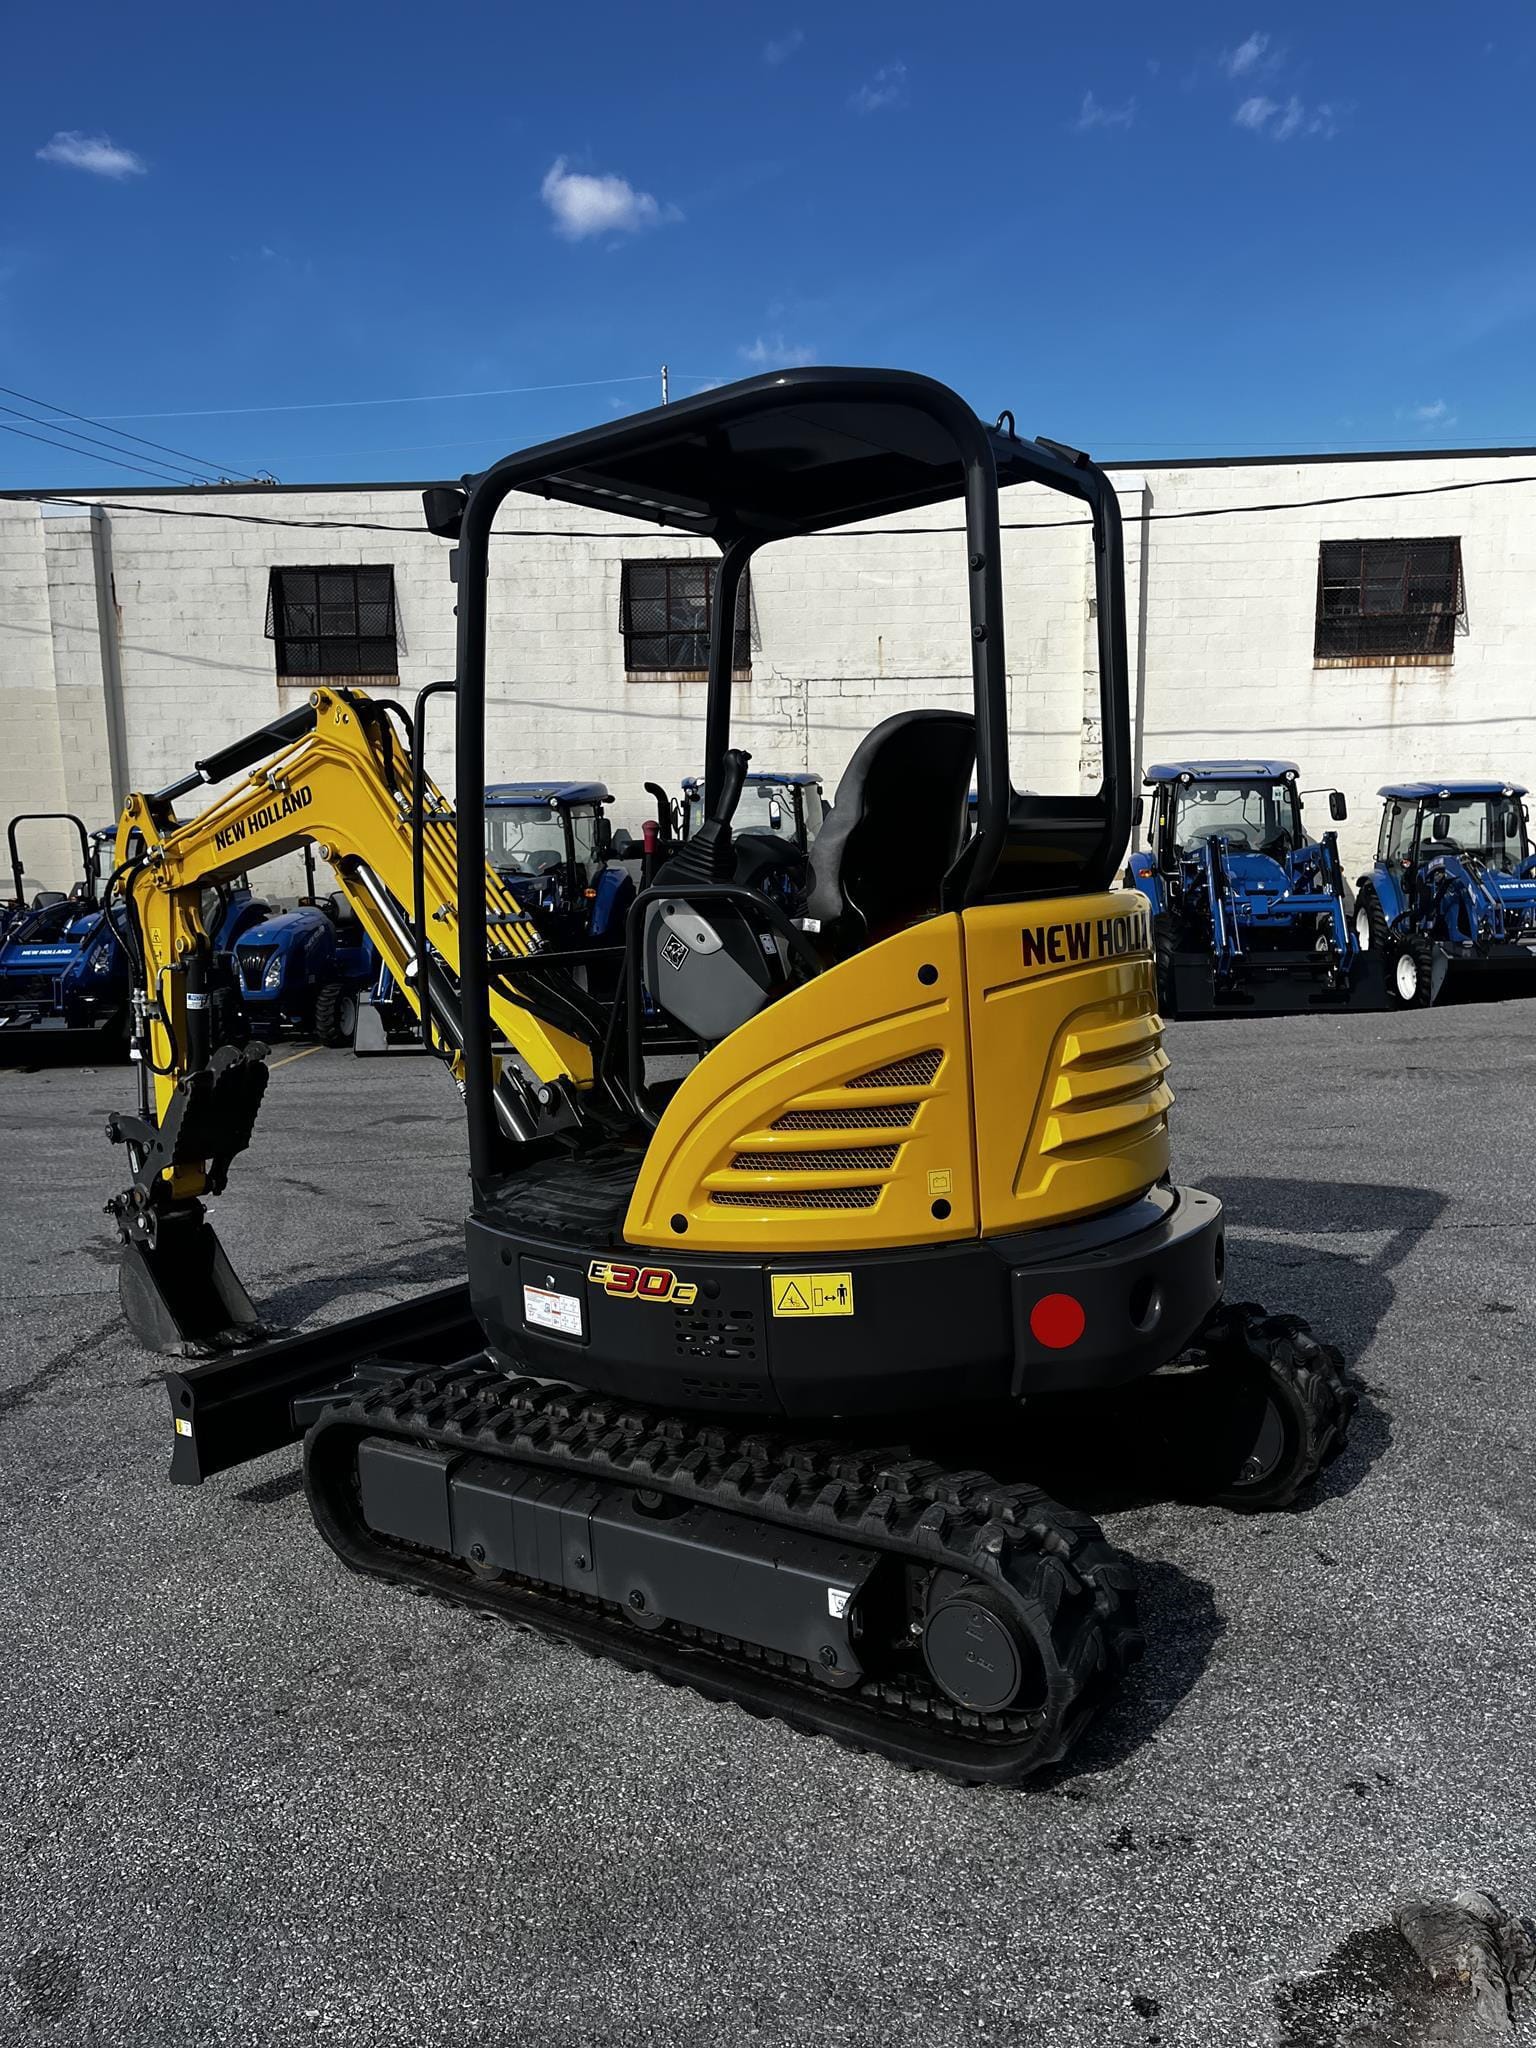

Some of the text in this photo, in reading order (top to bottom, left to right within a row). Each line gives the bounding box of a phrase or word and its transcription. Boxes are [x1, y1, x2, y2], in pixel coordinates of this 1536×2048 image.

[215, 785, 312, 851] NEW HOLLAND
[1022, 922, 1090, 966] NEW
